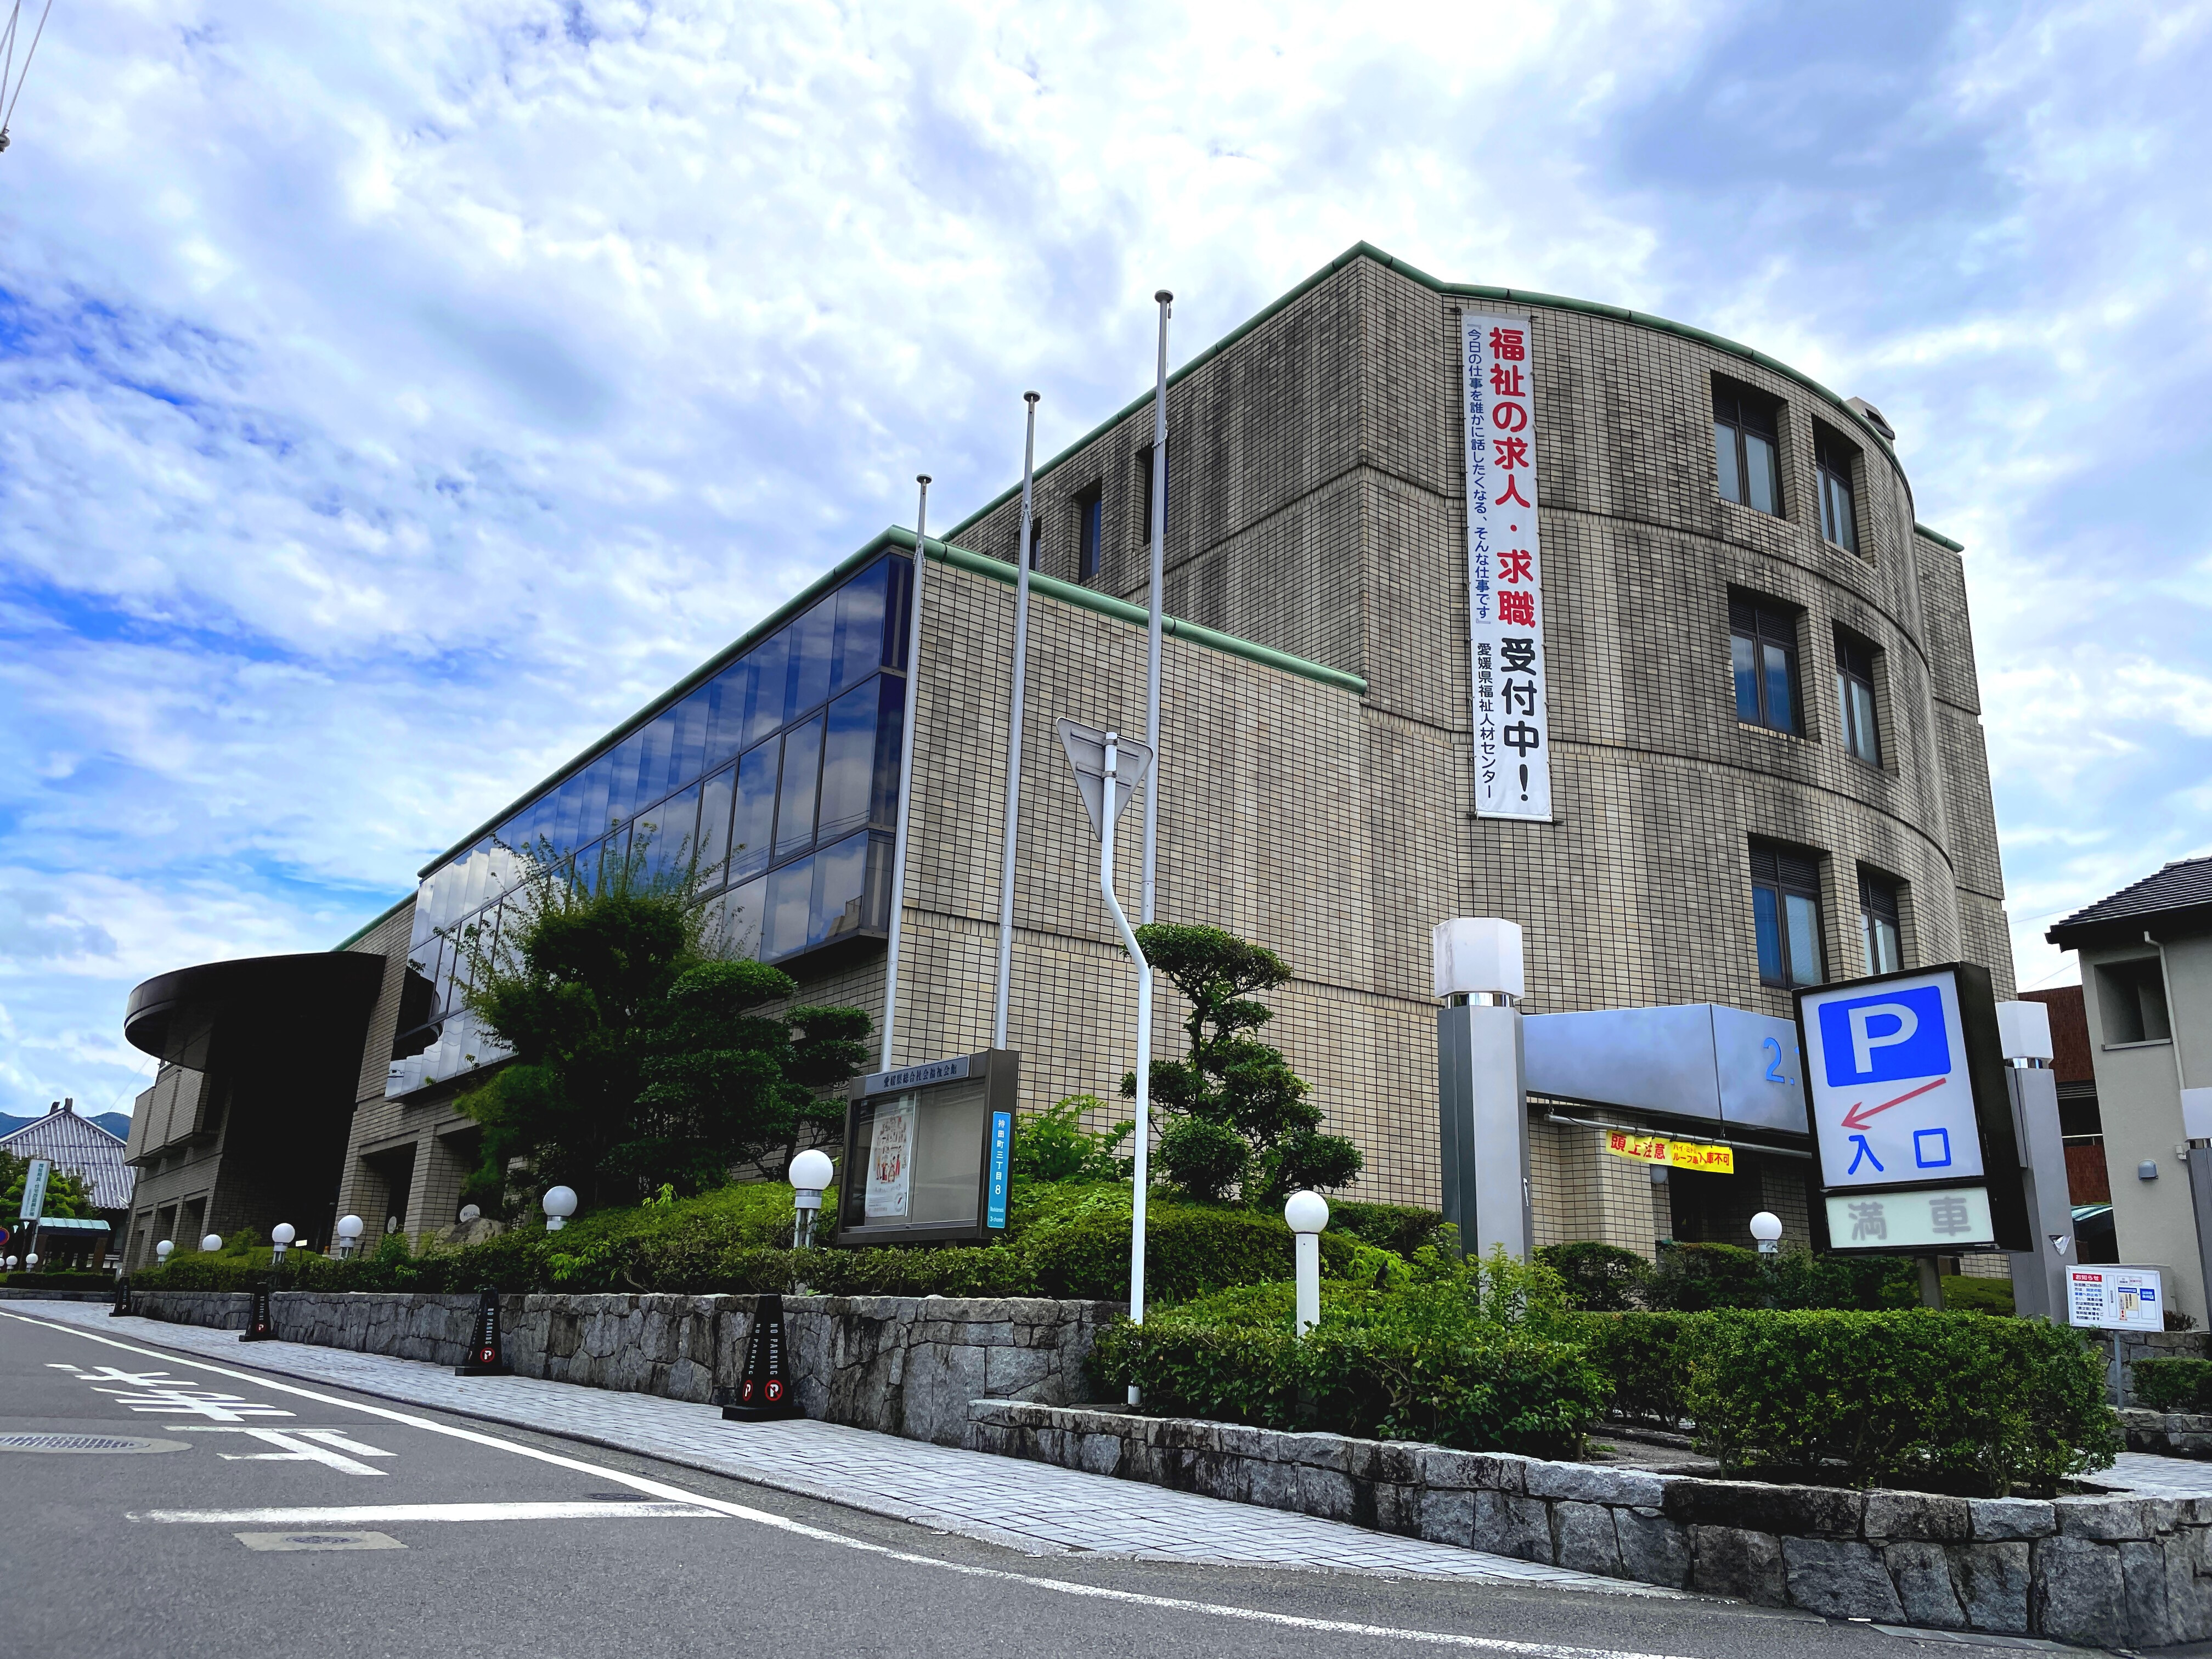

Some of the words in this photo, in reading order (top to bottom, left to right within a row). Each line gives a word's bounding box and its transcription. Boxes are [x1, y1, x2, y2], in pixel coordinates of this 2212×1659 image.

[1477, 642, 1496, 798] 愛媛県福祉人材センター
[1848, 1003, 1918, 1074] P
[884, 1063, 957, 1088] 愛媛県総合社会福祉会館
[1763, 1037, 1799, 1085] 2.
[1611, 1132, 1665, 1159] 頭上注意
[1698, 1152, 1729, 1166] 入庫不可
[1848, 1127, 1951, 1175] 入口
[1848, 1197, 1971, 1241] 満車
[755, 1323, 761, 1334] NO
[770, 1323, 778, 1334] NO
